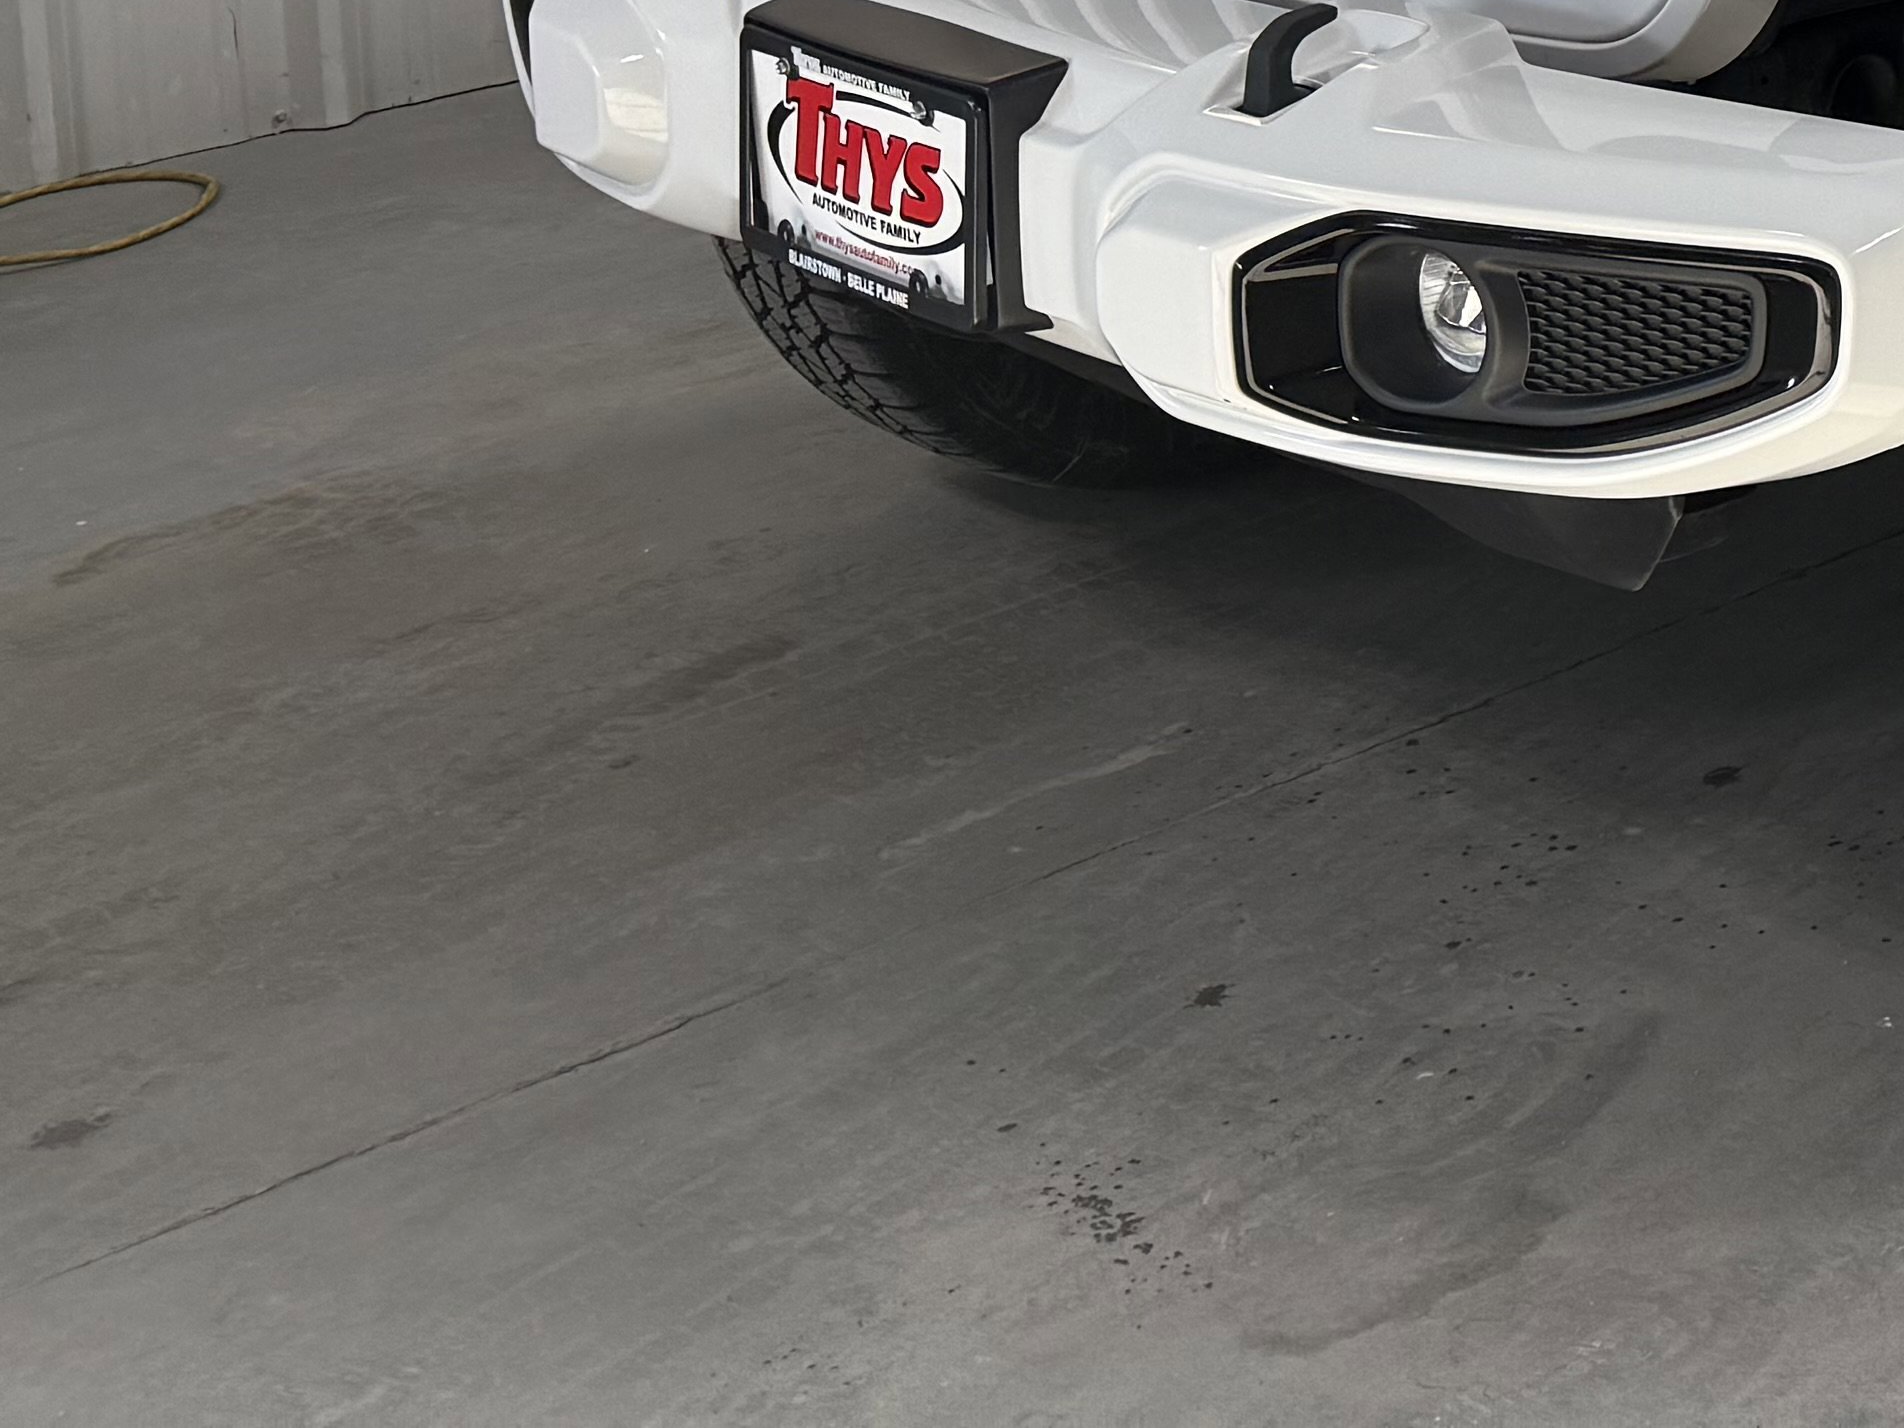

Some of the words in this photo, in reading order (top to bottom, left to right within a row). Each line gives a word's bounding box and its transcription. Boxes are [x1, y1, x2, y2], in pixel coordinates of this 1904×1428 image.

[822, 64, 877, 93] AUTOMOTIVE
[878, 82, 911, 102] FAMILY
[785, 76, 945, 229] THYS
[812, 192, 877, 231] AUTOMOTIVE
[880, 219, 922, 245] FAMILY
[788, 248, 842, 283] BLAIRSTOWN
[847, 272, 875, 297] BELLE
[876, 282, 910, 310] PLAINE
[815, 230, 914, 276] www.thysautofamily.co
